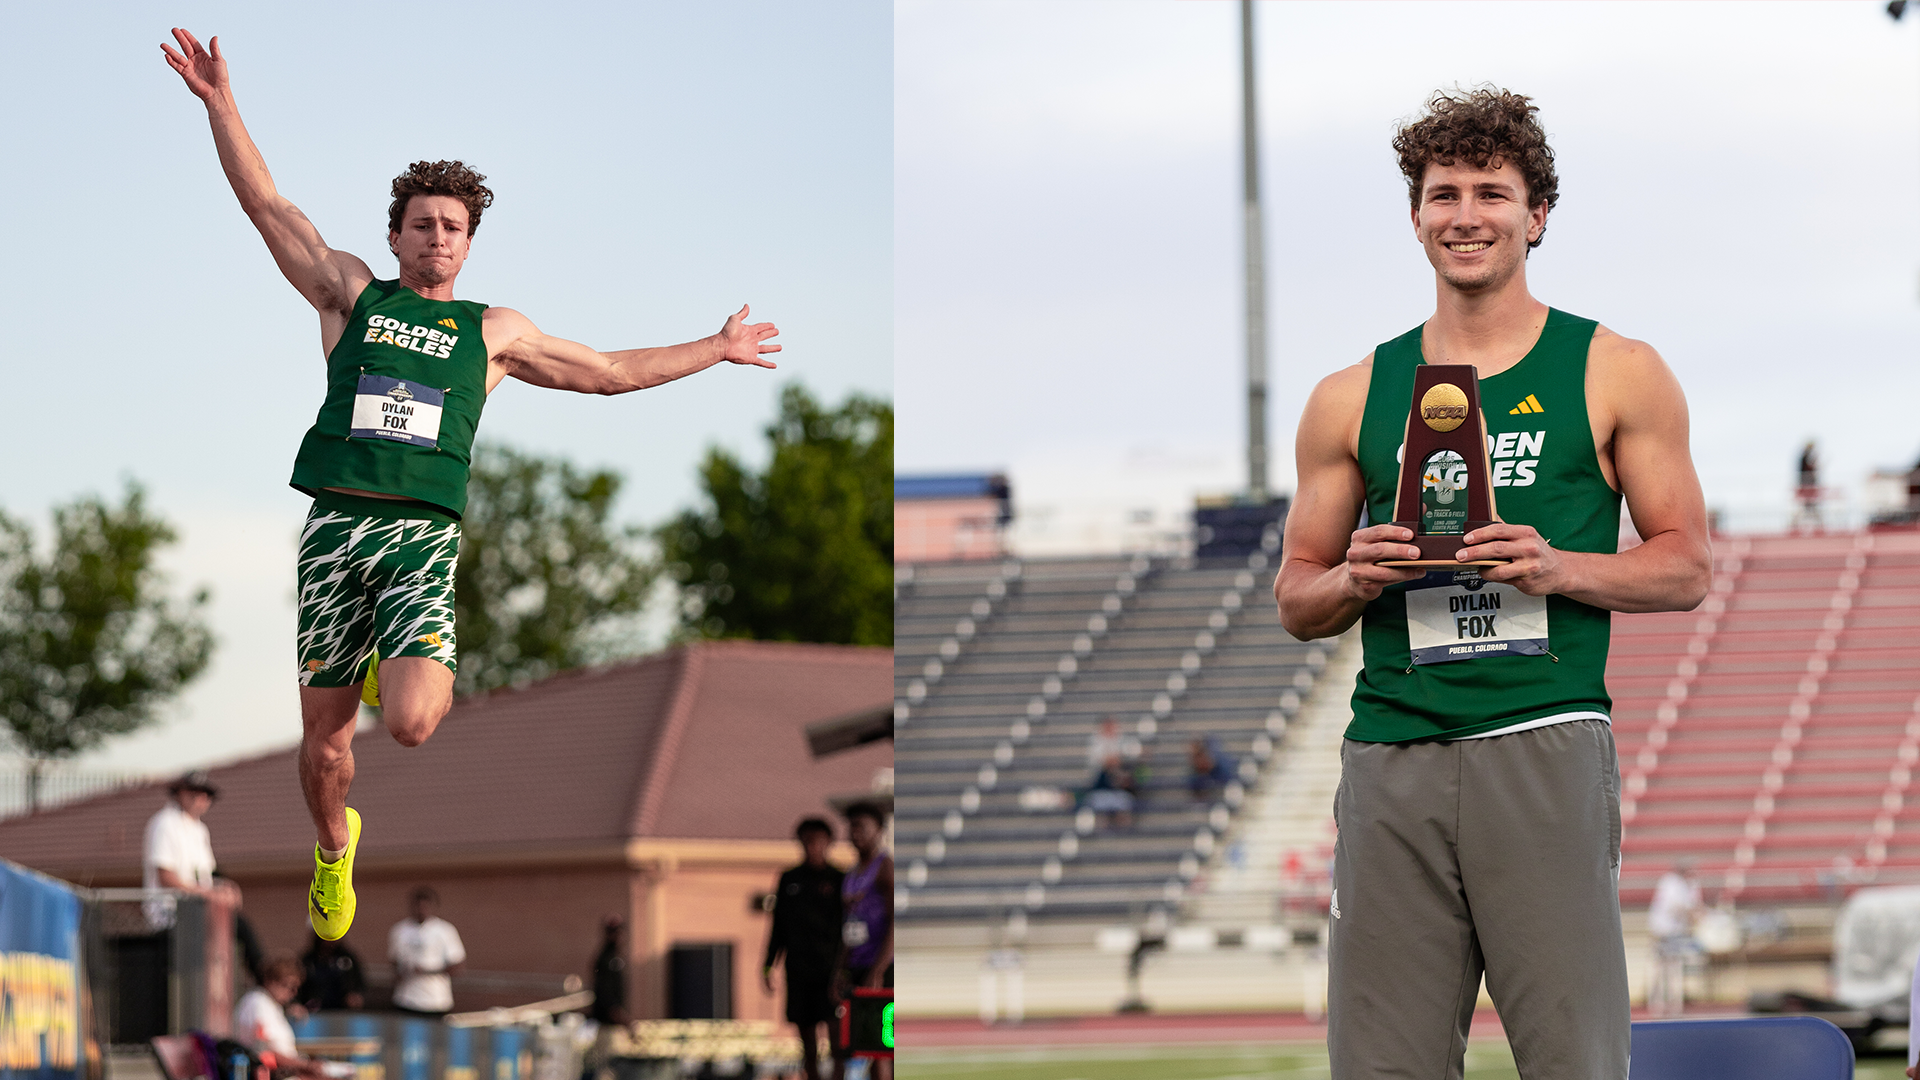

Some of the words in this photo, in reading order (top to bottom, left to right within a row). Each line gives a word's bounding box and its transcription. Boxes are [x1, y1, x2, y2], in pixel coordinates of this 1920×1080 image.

[367, 314, 459, 347] GOLDEN
[363, 327, 453, 359] EAGLES
[381, 402, 414, 416] DYLAN
[1424, 405, 1466, 419] NCAA
[383, 415, 408, 430] FOX
[1449, 593, 1501, 613] DYLAN
[1457, 615, 1497, 639] FOX
[1449, 645, 1475, 655] PUEBLO,
[1475, 643, 1508, 653] COLORADO
